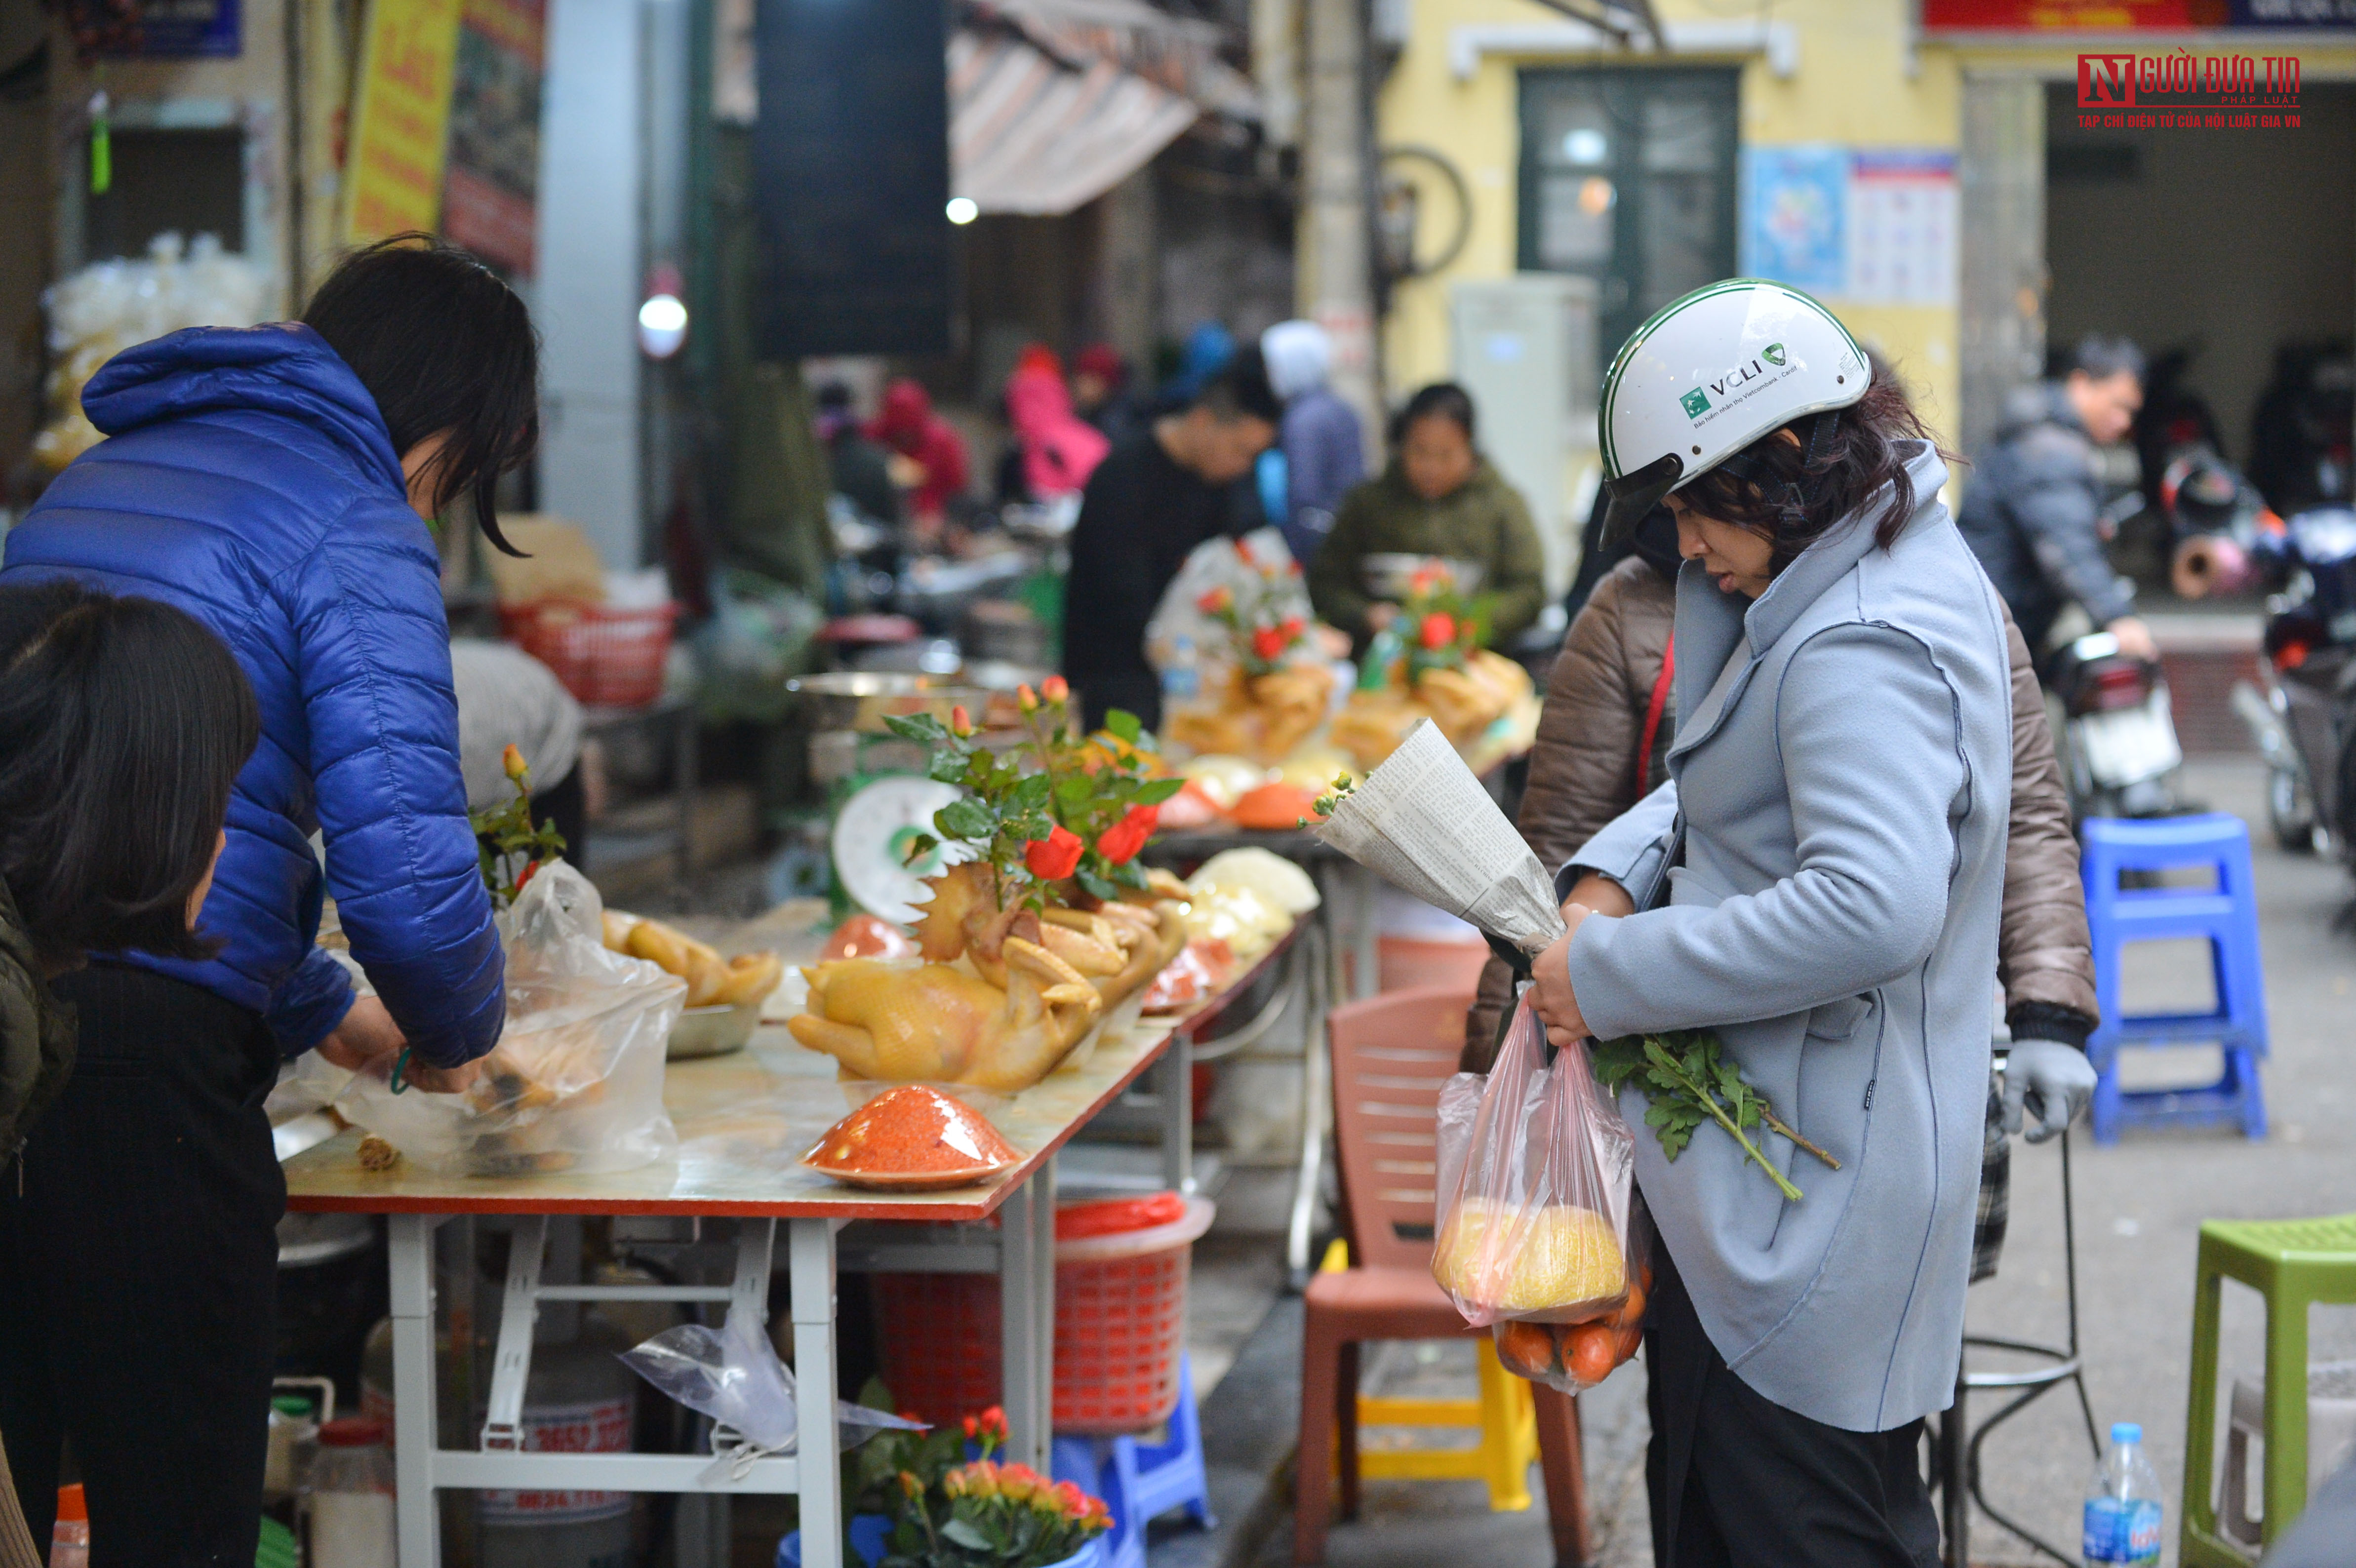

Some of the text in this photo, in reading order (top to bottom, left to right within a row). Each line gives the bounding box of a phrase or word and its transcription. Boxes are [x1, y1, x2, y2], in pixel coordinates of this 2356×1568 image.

[1710, 359, 1763, 395] VCLI
[1743, 377, 1779, 399] Vietcombank
[1781, 366, 1797, 377] Cardif
